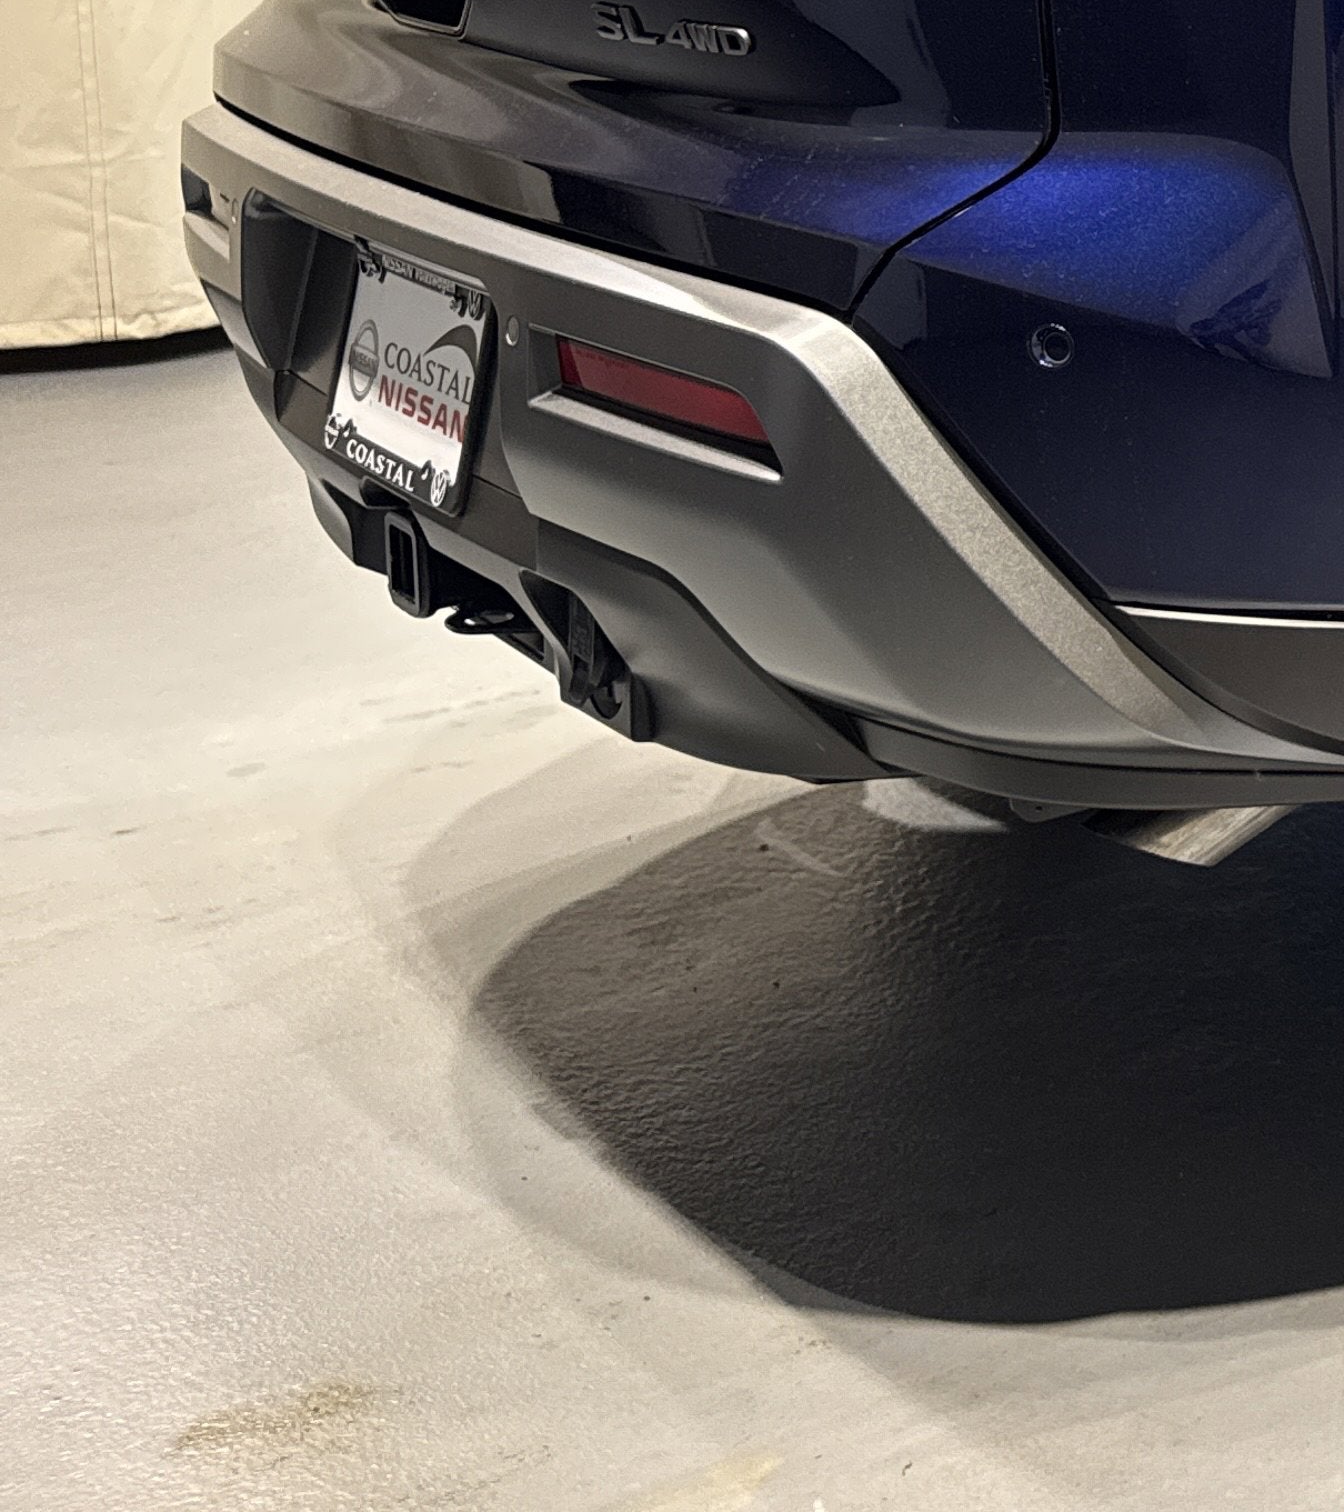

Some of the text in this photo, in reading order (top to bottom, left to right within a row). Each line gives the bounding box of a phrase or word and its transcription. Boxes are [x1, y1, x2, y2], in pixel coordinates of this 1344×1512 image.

[591, 1, 752, 57] SL 4WD
[384, 342, 472, 405] COASTAL
[378, 374, 470, 443] NISSAN
[346, 438, 415, 492] COASTAL
